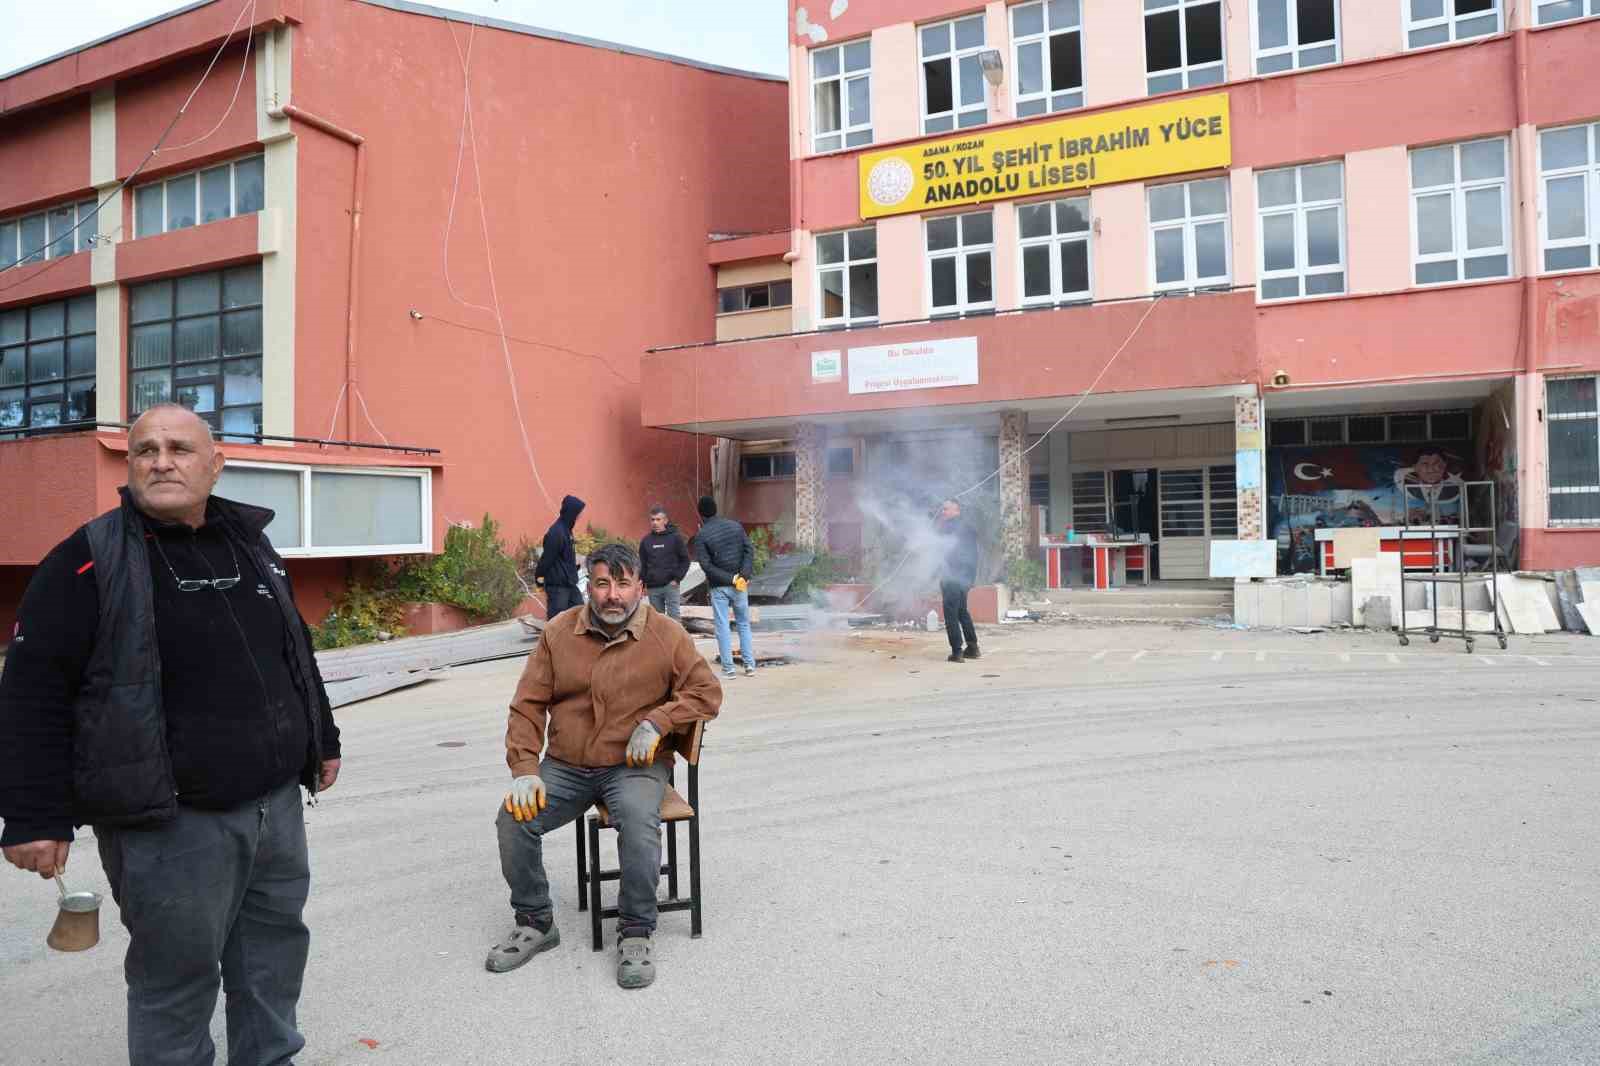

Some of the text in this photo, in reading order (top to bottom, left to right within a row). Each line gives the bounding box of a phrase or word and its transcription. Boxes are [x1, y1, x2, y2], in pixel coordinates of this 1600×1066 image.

[923, 145, 950, 157] ADANA
[956, 139, 984, 152] KOZAN
[924, 160, 949, 180] 50.
[992, 141, 1052, 173] ŞEHİT
[1059, 126, 1149, 159] İBRAHİM
[1160, 115, 1222, 143] YÜCE
[924, 173, 1020, 203] ANADOLU
[1028, 156, 1096, 188] LİSESİ
